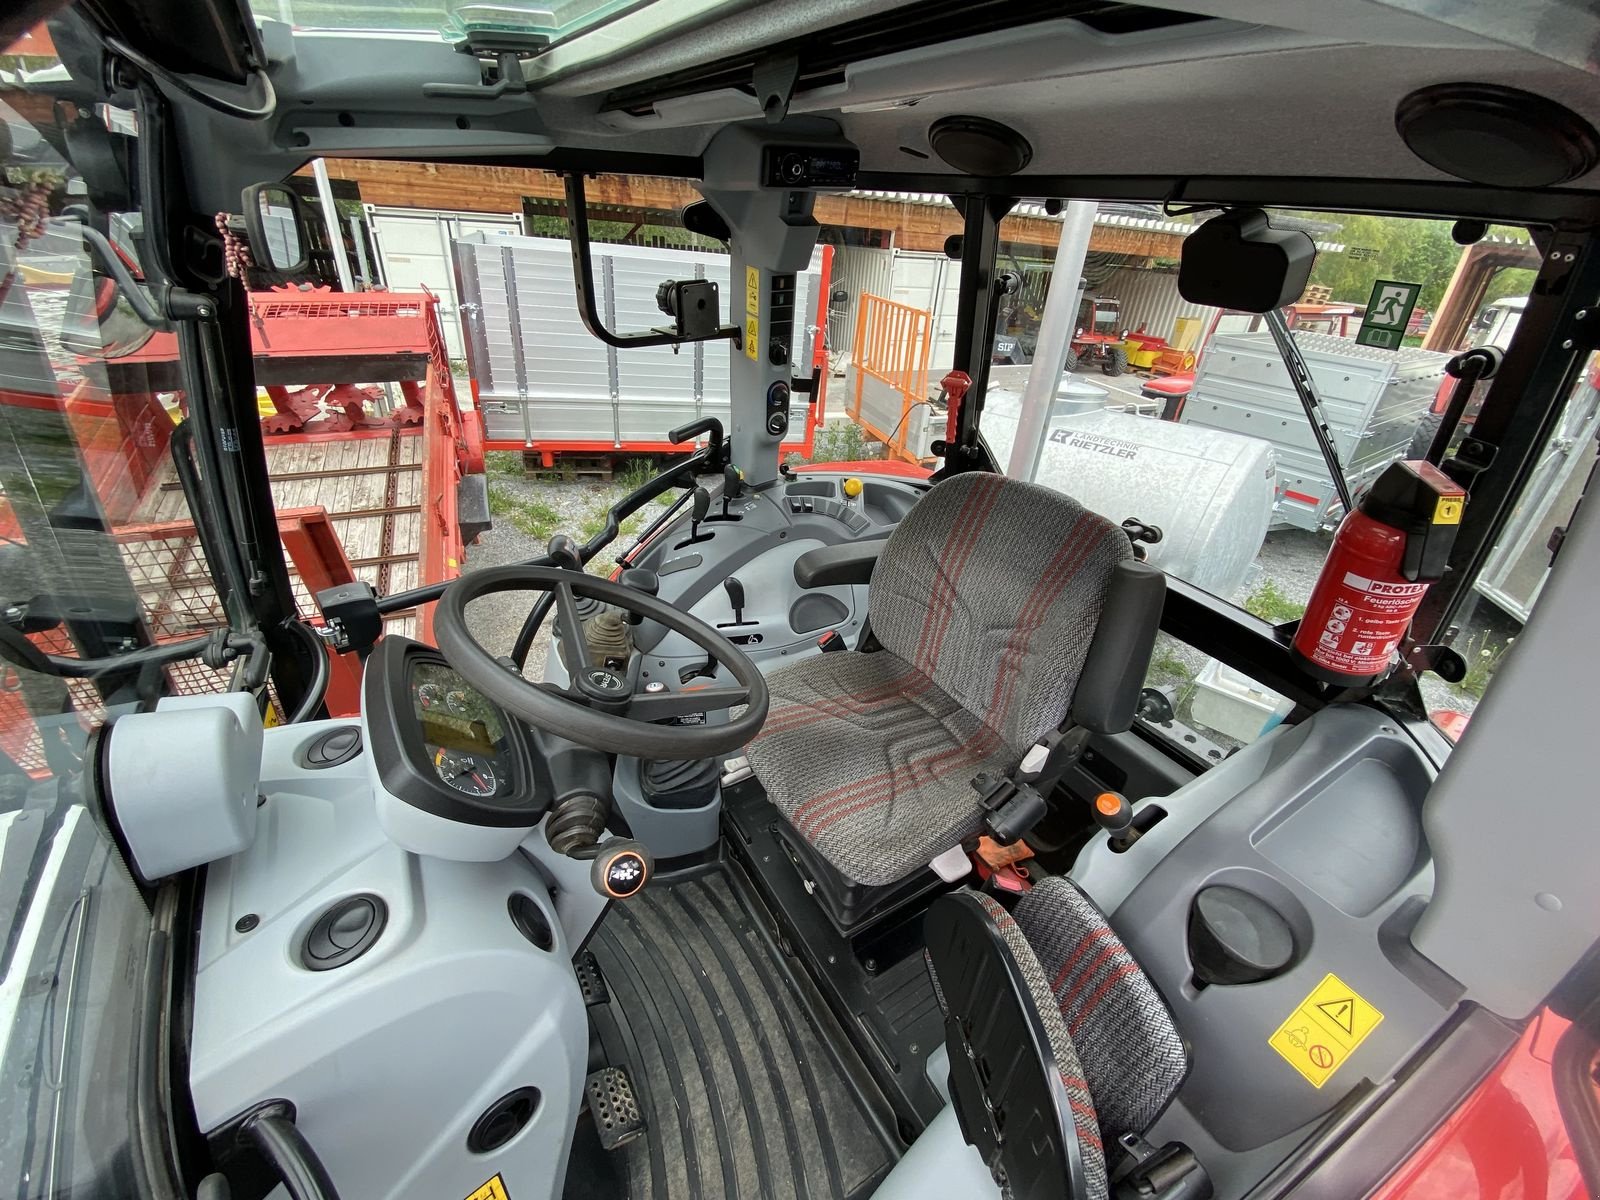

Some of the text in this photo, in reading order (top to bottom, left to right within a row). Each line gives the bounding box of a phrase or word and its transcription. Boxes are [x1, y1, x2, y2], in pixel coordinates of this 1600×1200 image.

[997, 342, 1014, 352] SIP
[1074, 432, 1140, 451] LANDTECHNIK
[1069, 438, 1137, 460] RIETZLER
[1445, 505, 1451, 516] 1
[1370, 582, 1424, 594] PROTEX
